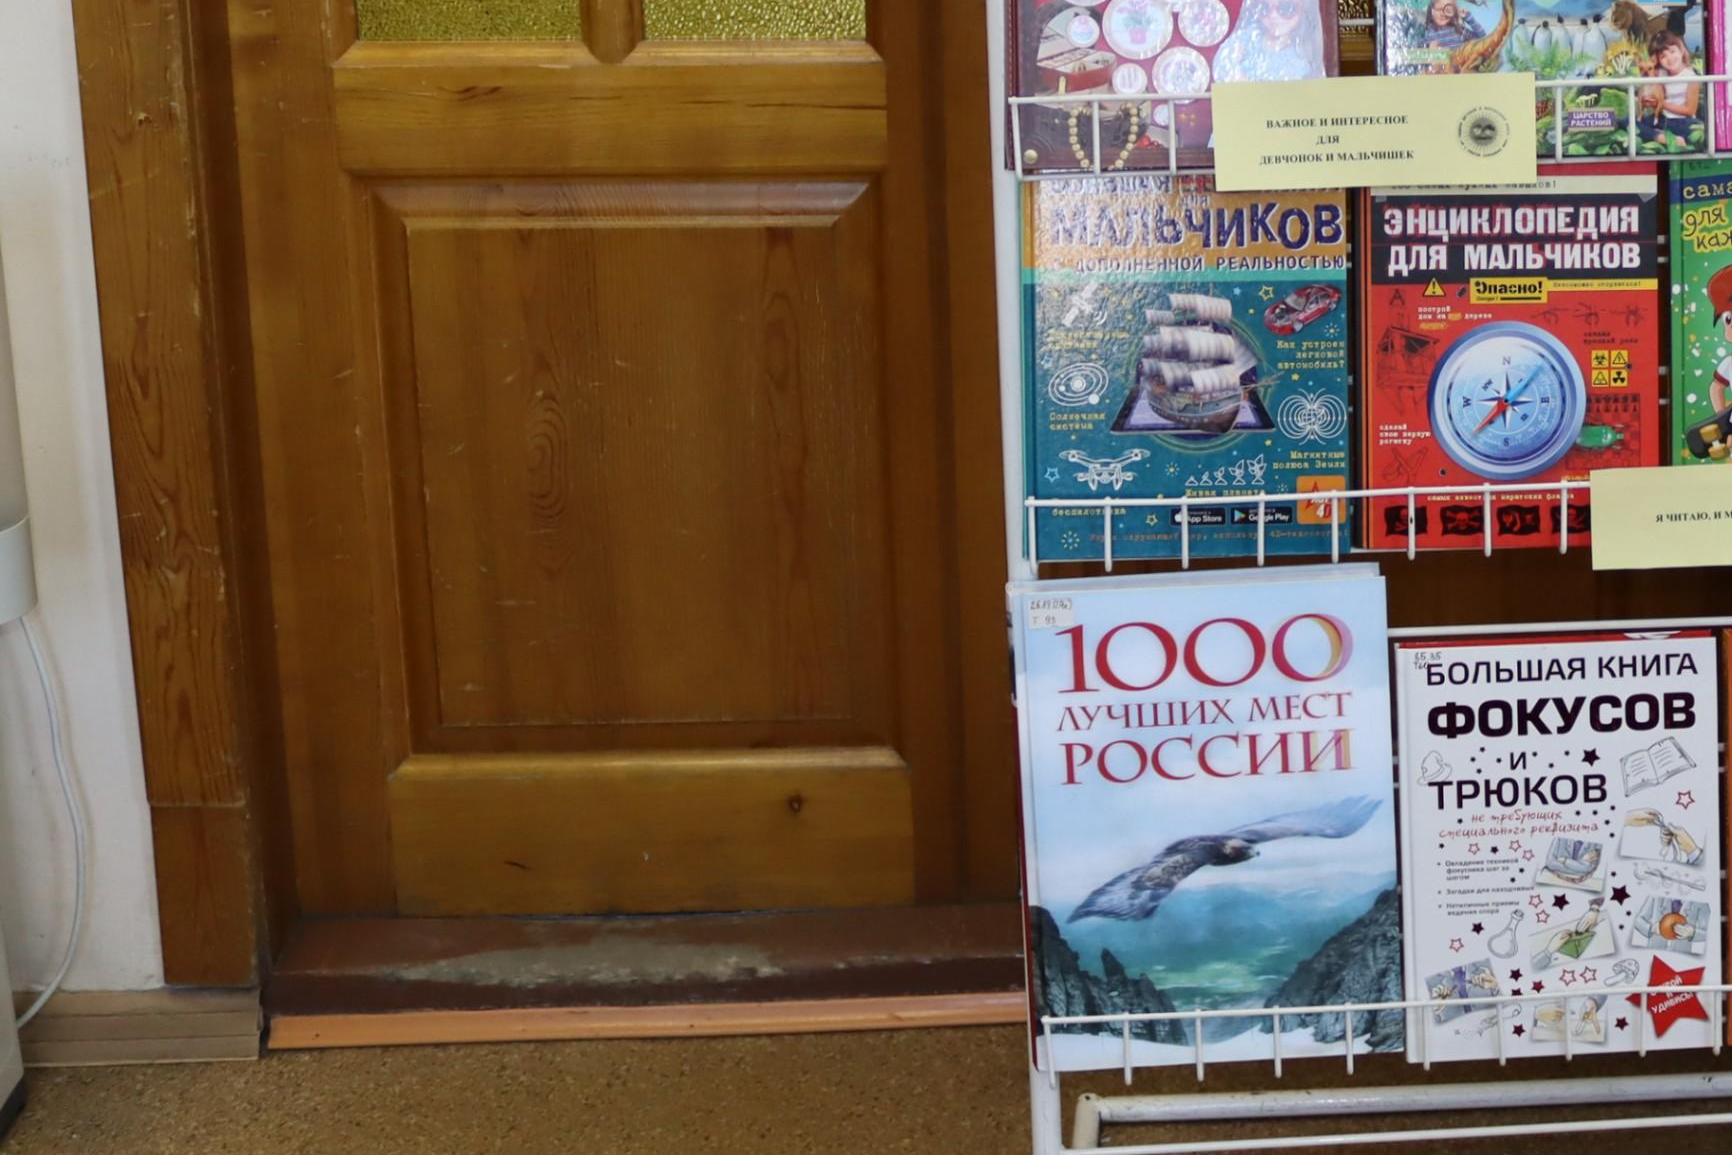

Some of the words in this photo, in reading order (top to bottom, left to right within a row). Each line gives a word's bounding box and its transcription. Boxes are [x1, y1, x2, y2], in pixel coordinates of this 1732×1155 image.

[1266, 116, 1317, 129] ВАЖНОЕ
[1320, 117, 1328, 127] И
[1331, 115, 1408, 126] ИНТЕРЕСНОЕ
[1316, 134, 1339, 145] ДЛЯ
[1260, 153, 1323, 165] ДЕВЧОНОК
[1326, 153, 1334, 162] И
[1337, 150, 1414, 161] МАЛЬЧИШЕК
[1051, 203, 1343, 249] МАЛЬЧИКОВ
[1384, 206, 1638, 242] ЭНЦИКЛОПЕДИЯ
[1683, 204, 1726, 238] для
[1217, 255, 1344, 270] РЕАЛЬНОСТЬЮ
[1388, 245, 1448, 277] ДЛЯ
[1464, 243, 1641, 270] МАЛЬЧИКОВ
[1656, 514, 1663, 522] Я
[1667, 512, 1711, 522] ЧИТАЮ,
[1714, 512, 1721, 520] И
[1055, 614, 1353, 693] 1000
[1427, 658, 1586, 686] БОЛЬШАЯ
[1598, 653, 1698, 678] КНИГА
[1058, 699, 1234, 732] ЛУЧШИХ
[1249, 692, 1352, 722] МЕСТ
[1428, 692, 1696, 738] ФОКУСОВ
[1060, 729, 1357, 785] РОССИИ
[1510, 752, 1527, 769] И
[1429, 775, 1608, 809] ТРЮКОВ
